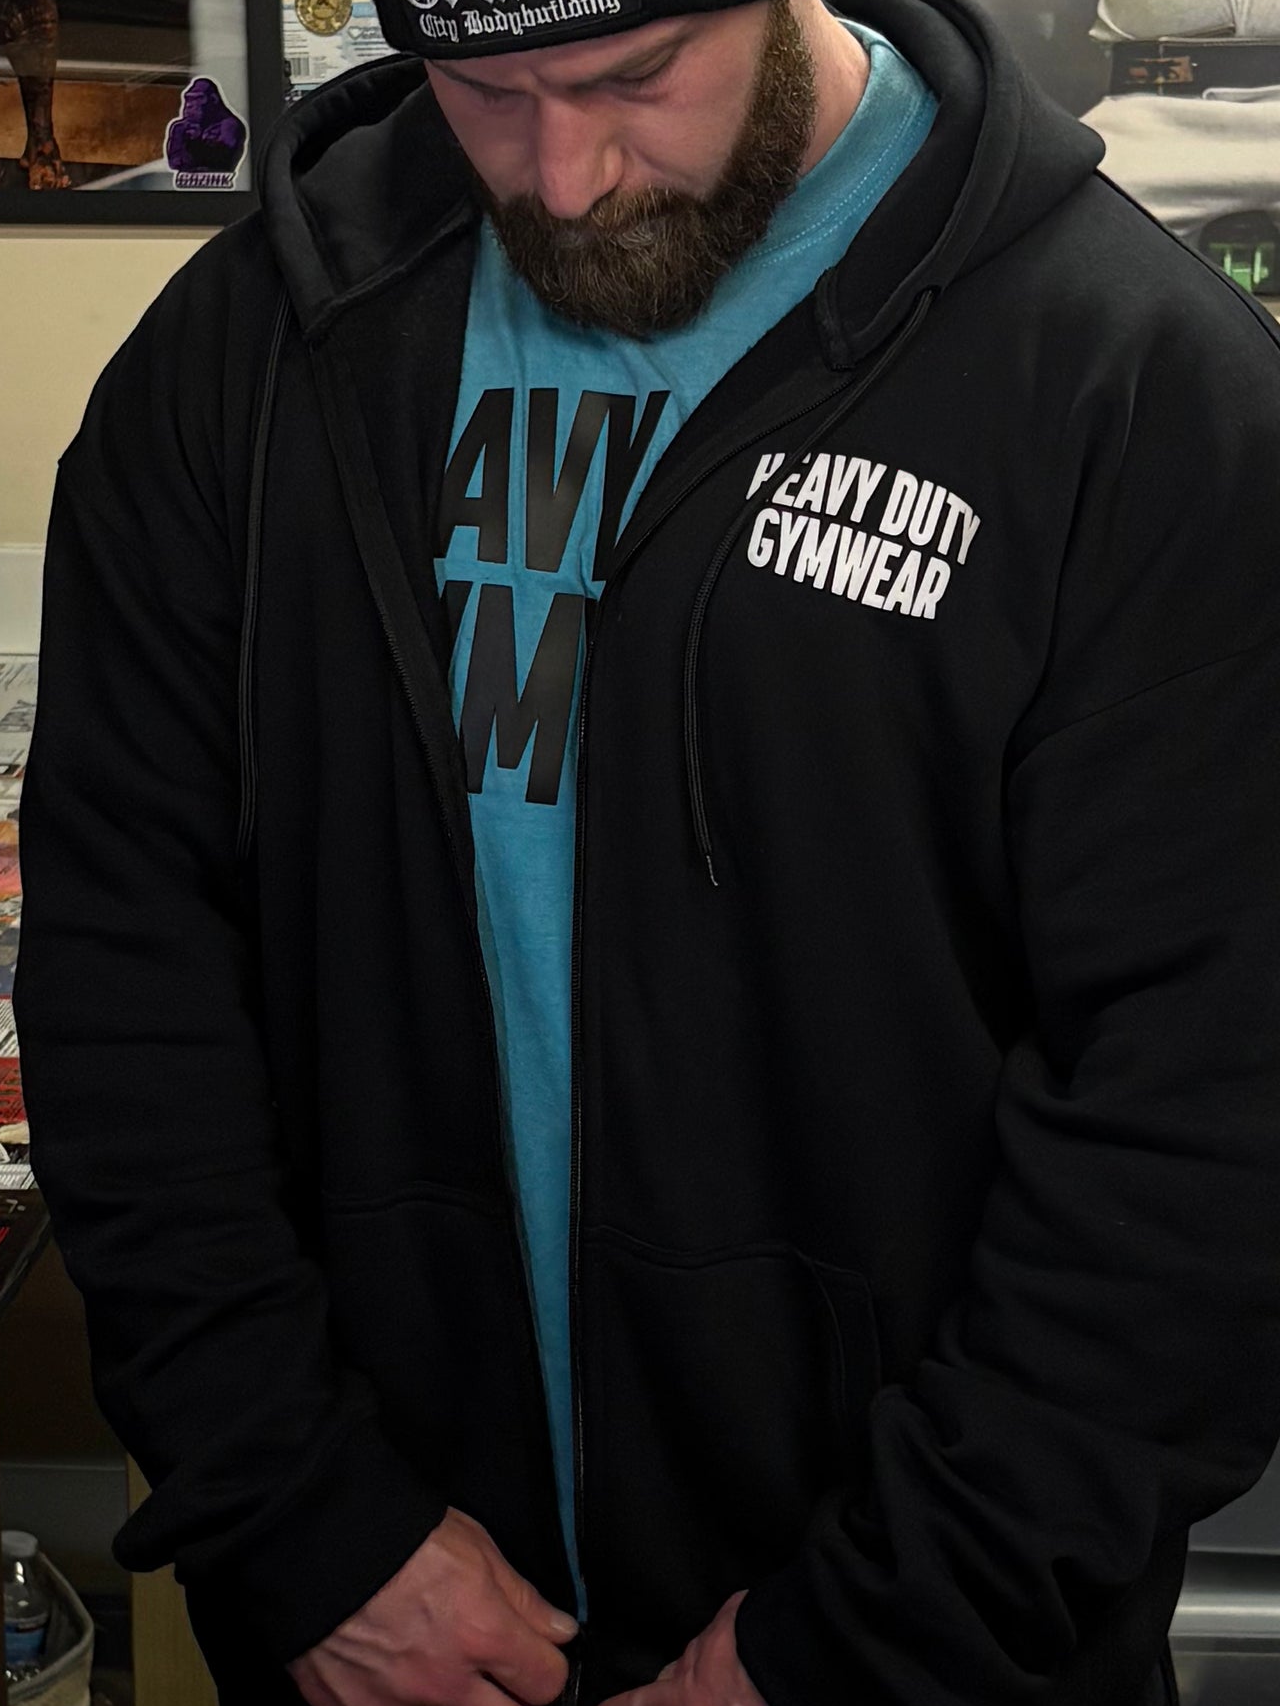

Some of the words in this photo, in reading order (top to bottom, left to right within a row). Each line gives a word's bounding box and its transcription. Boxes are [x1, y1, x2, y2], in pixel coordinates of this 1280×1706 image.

[419, 12, 460, 43] City
[435, 386, 672, 582] AVY
[745, 452, 888, 524] HEAVY
[878, 468, 981, 566] DUTY
[746, 507, 952, 621] GYMWEAR
